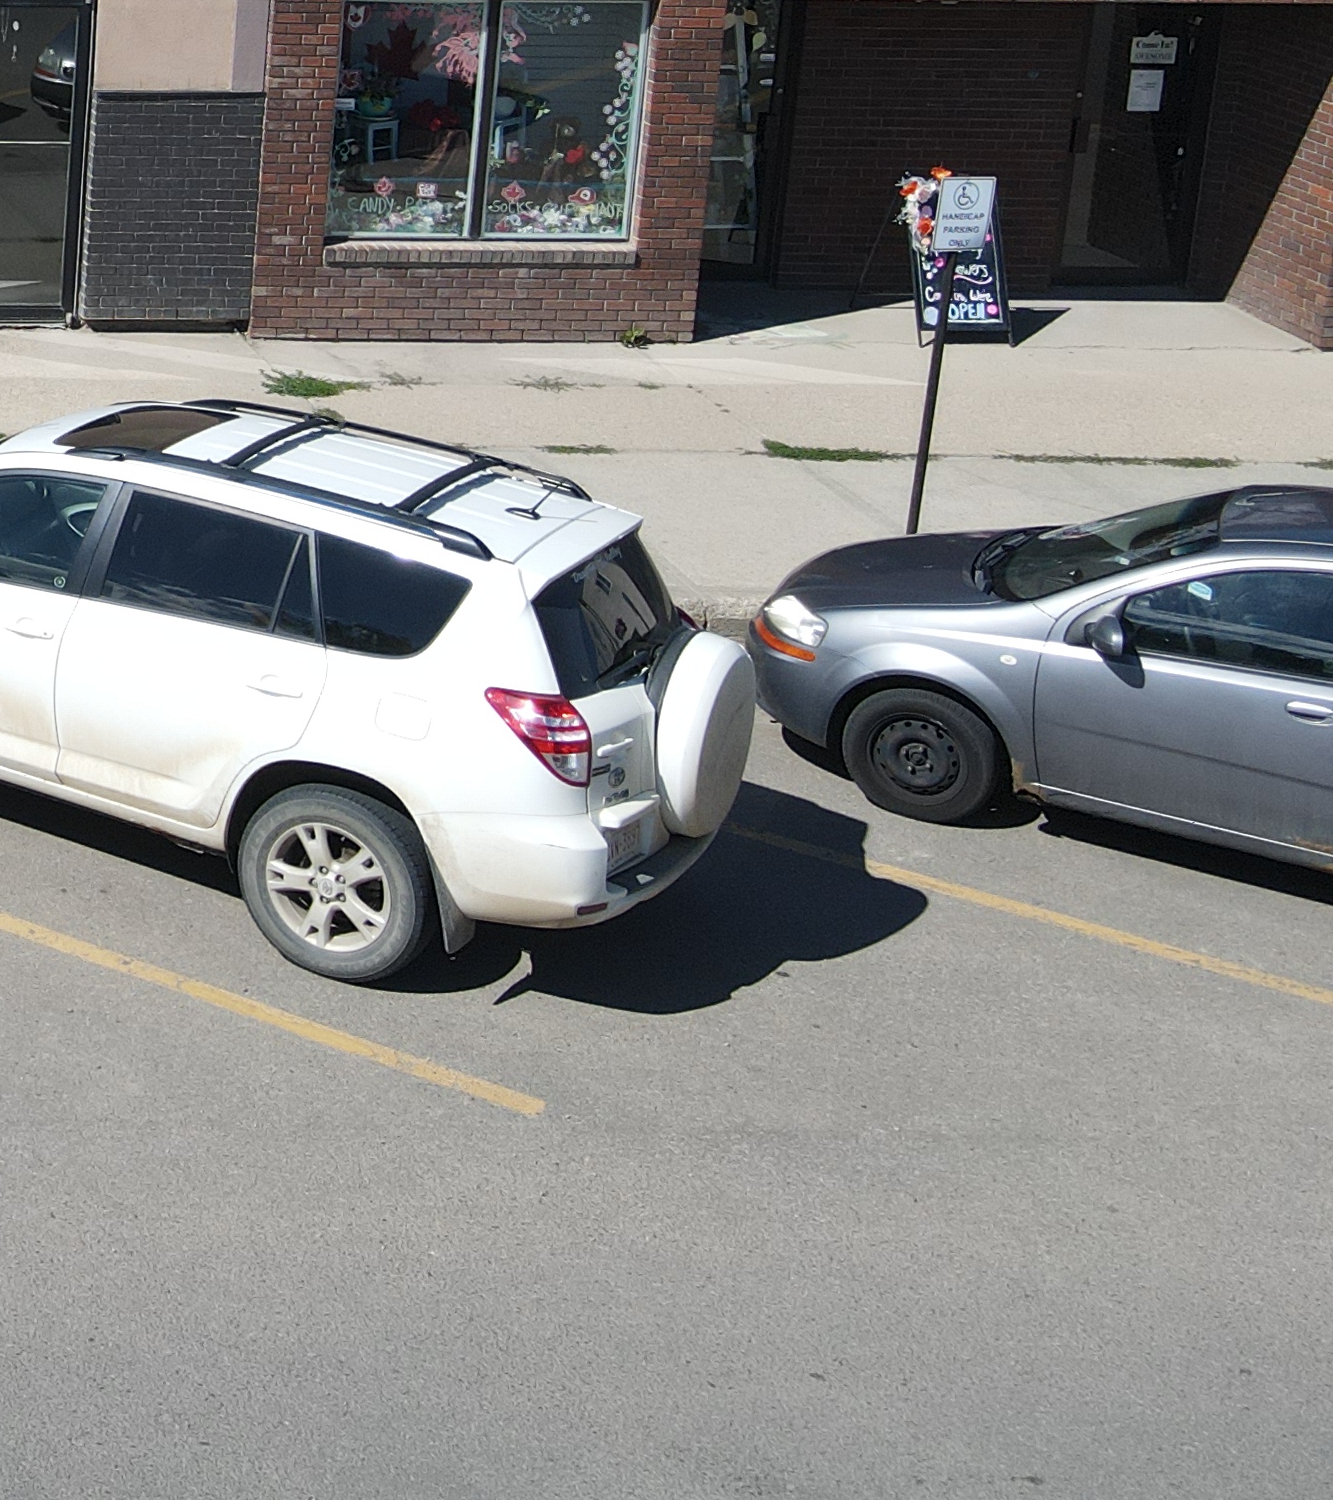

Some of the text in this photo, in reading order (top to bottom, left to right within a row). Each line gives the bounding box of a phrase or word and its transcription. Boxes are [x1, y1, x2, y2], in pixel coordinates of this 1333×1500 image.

[346, 196, 395, 214] CANDY
[490, 199, 534, 213] SOCKS
[942, 213, 985, 221] HANDICAP
[942, 226, 980, 234] PARKING
[948, 239, 971, 248] ONLY
[948, 303, 986, 320] OPEN
